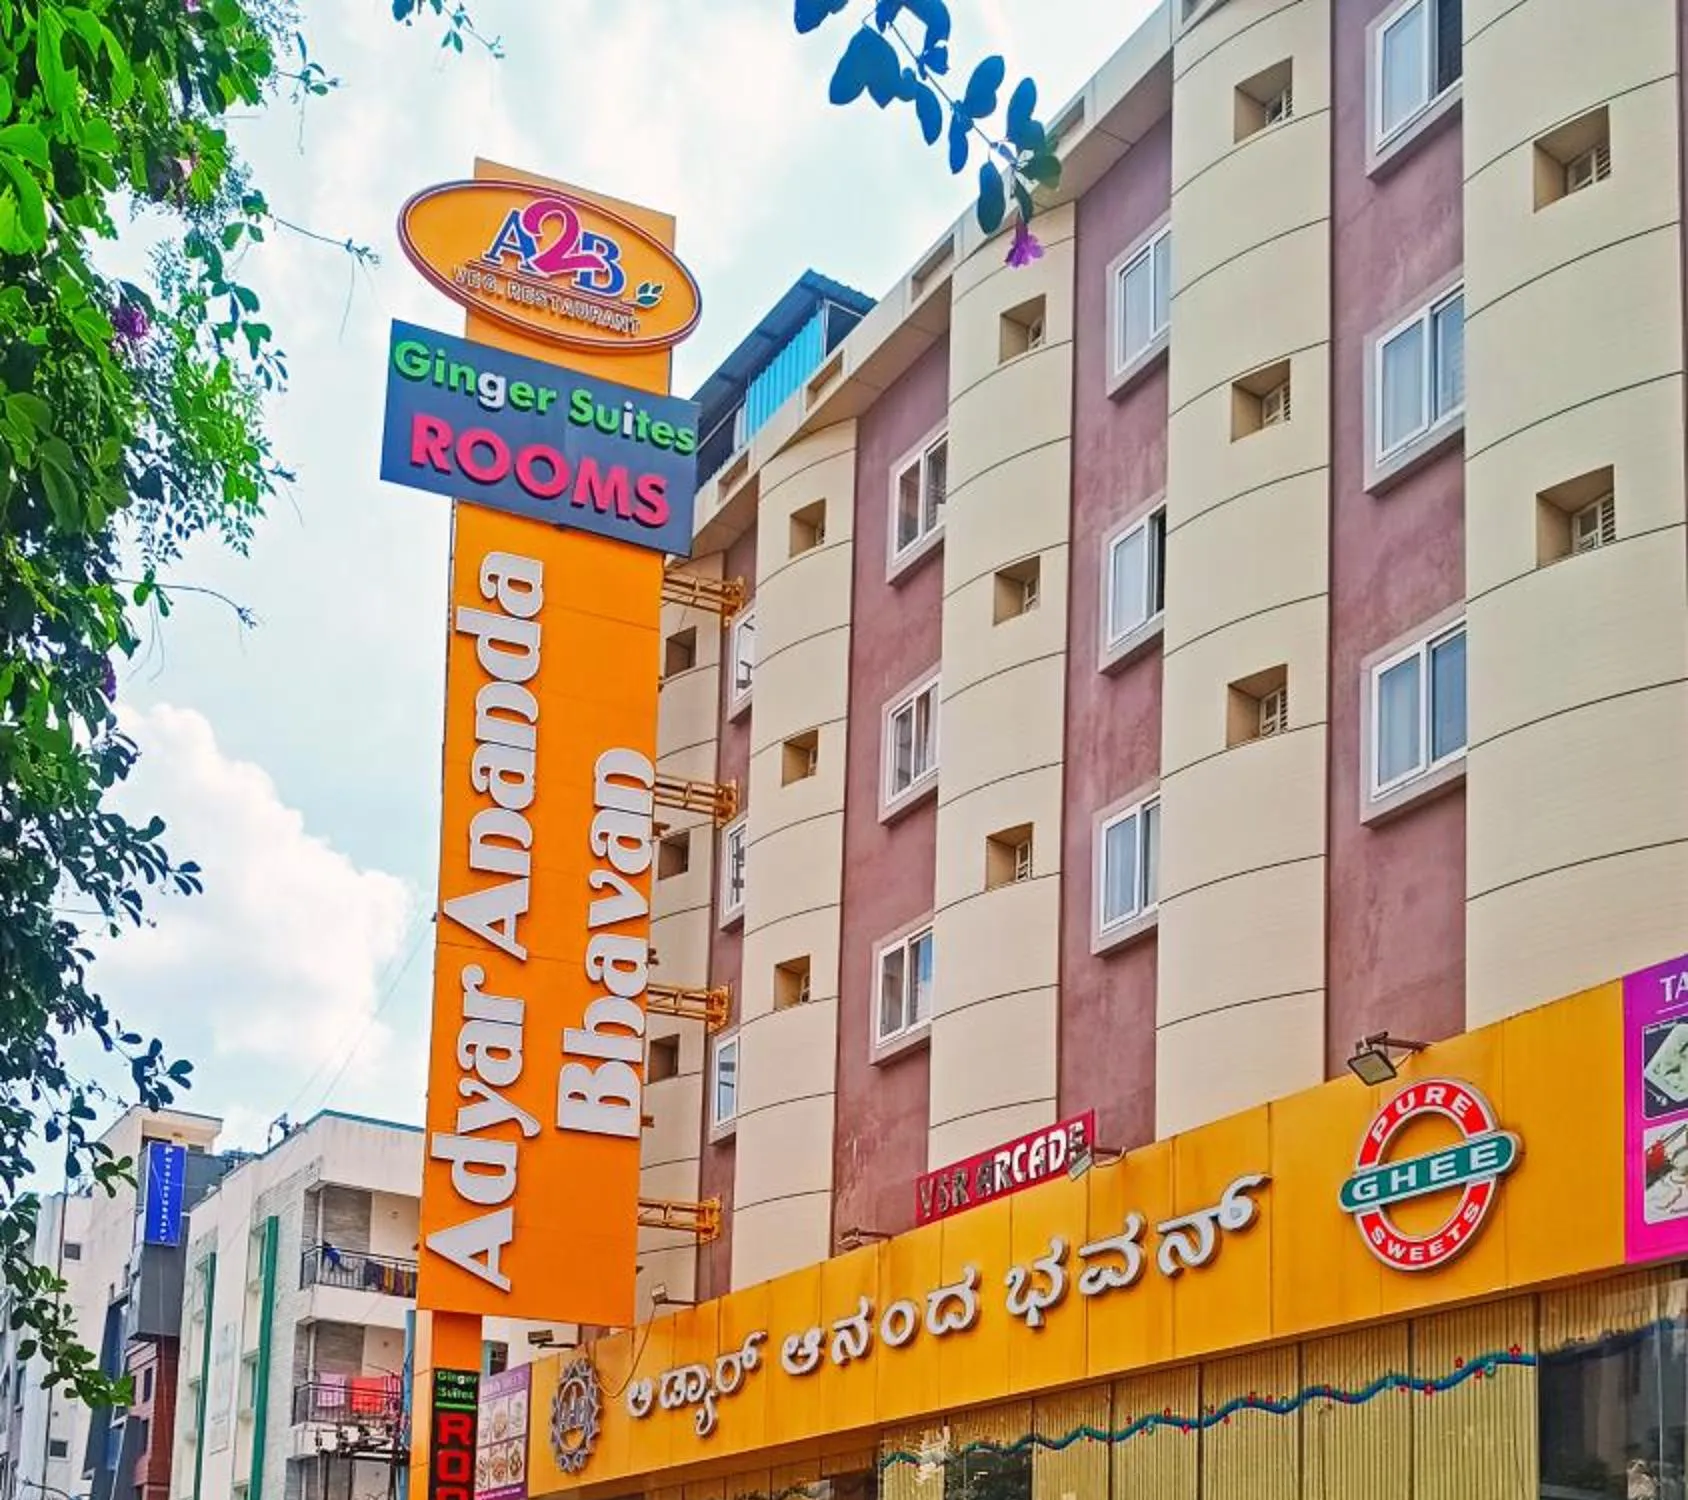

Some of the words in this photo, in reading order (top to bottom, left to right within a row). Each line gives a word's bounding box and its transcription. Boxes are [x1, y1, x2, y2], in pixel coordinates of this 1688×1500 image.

[481, 198, 627, 297] A2B
[507, 281, 641, 335] RESTAURANT
[394, 339, 558, 415] Ginger
[567, 387, 698, 456] Suites
[409, 411, 672, 528] ROOMS
[442, 550, 545, 961] Ananda
[555, 746, 656, 1139] Bhavan
[425, 963, 541, 1294] Adyar
[1371, 1085, 1474, 1144] PURE
[919, 1167, 971, 1218] VSR
[976, 1120, 1086, 1198] ARCADE
[1351, 1140, 1500, 1201] GHEE
[780, 1265, 978, 1375] ಆನಂದ
[1005, 1173, 1271, 1328] ಭವನ್
[1370, 1202, 1482, 1262] SWEETS
